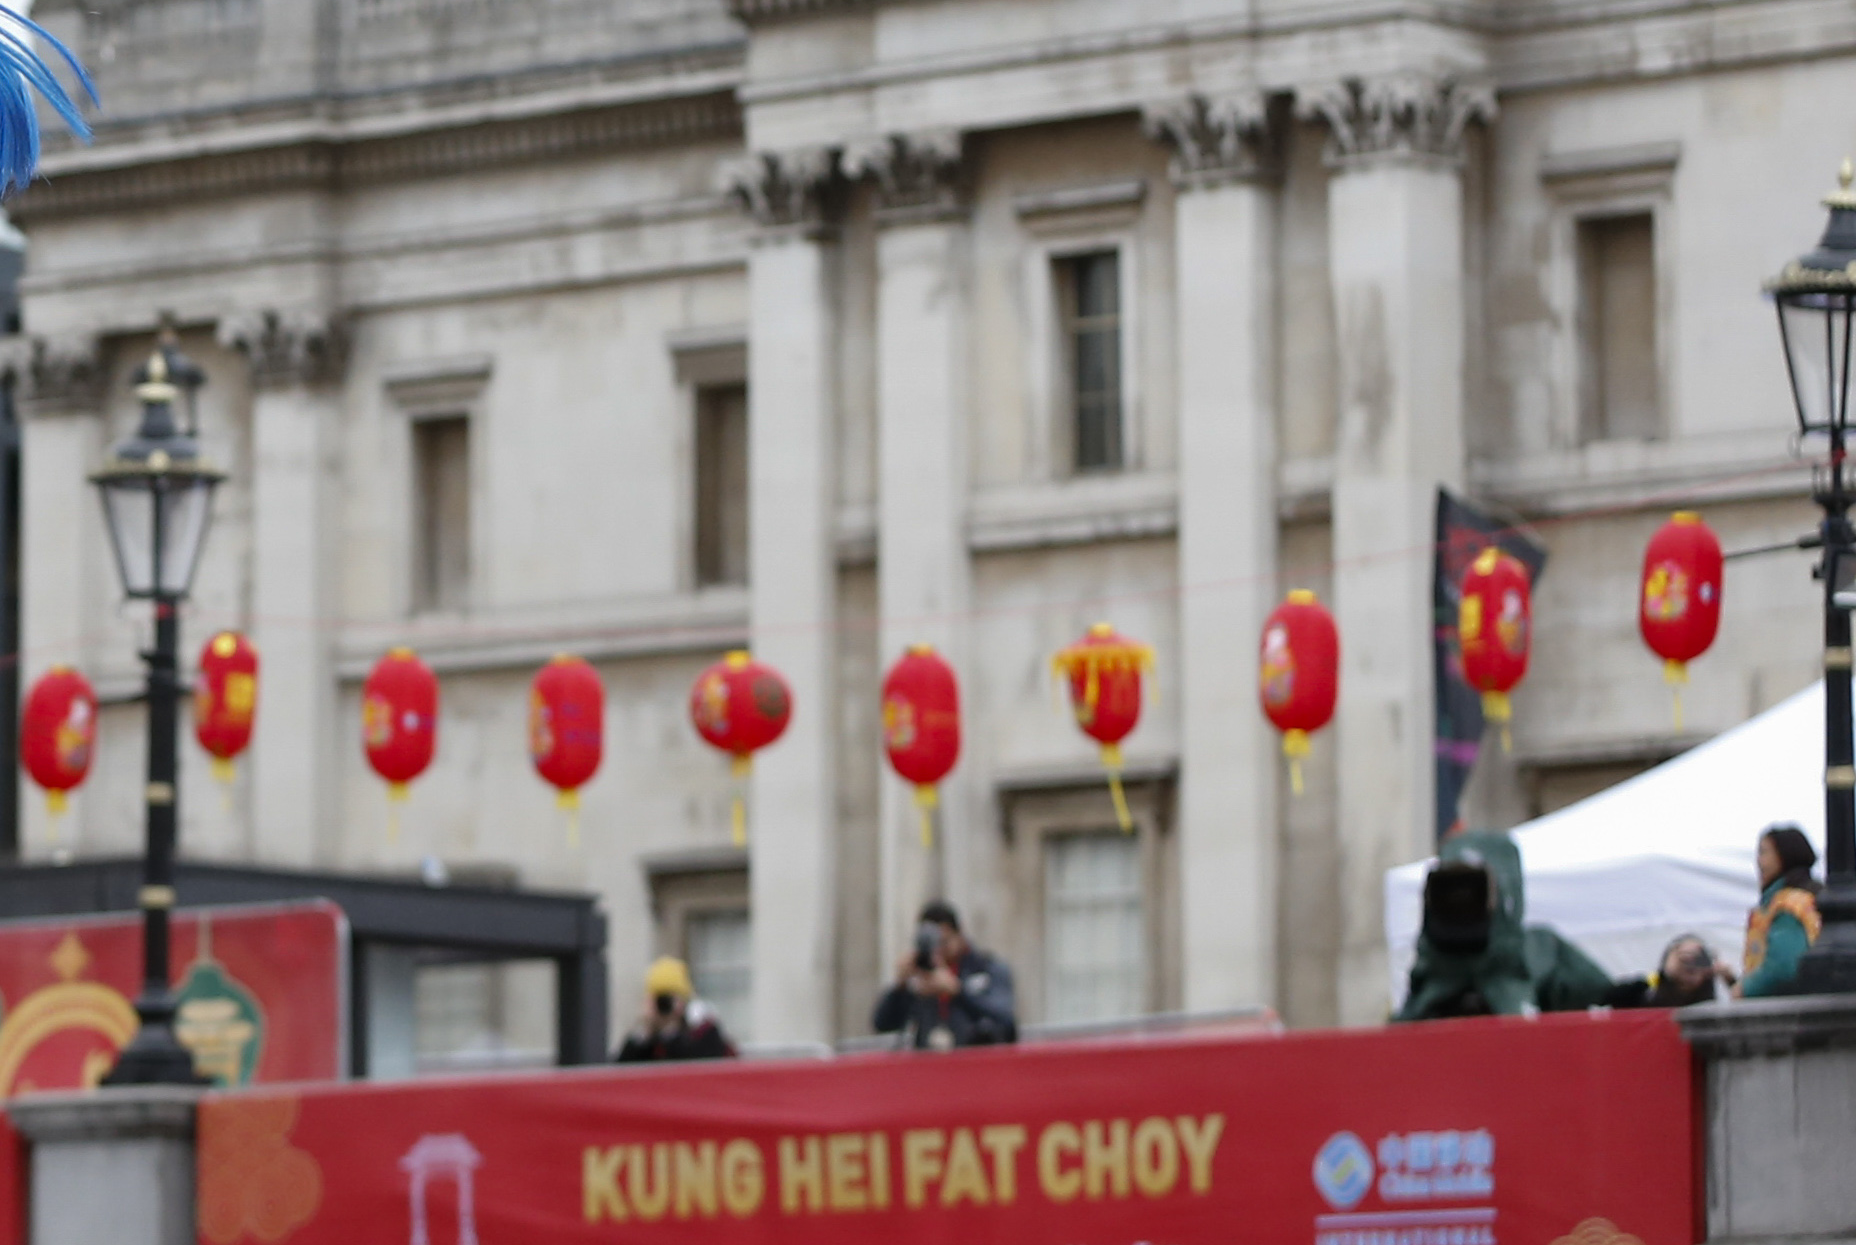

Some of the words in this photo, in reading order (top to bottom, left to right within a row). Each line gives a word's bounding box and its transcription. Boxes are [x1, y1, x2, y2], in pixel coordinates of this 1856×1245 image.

[582, 1138, 766, 1224] KUNG
[778, 1130, 889, 1216] HEI
[902, 1123, 1026, 1209] FAT
[1038, 1113, 1224, 1203] CHOY
